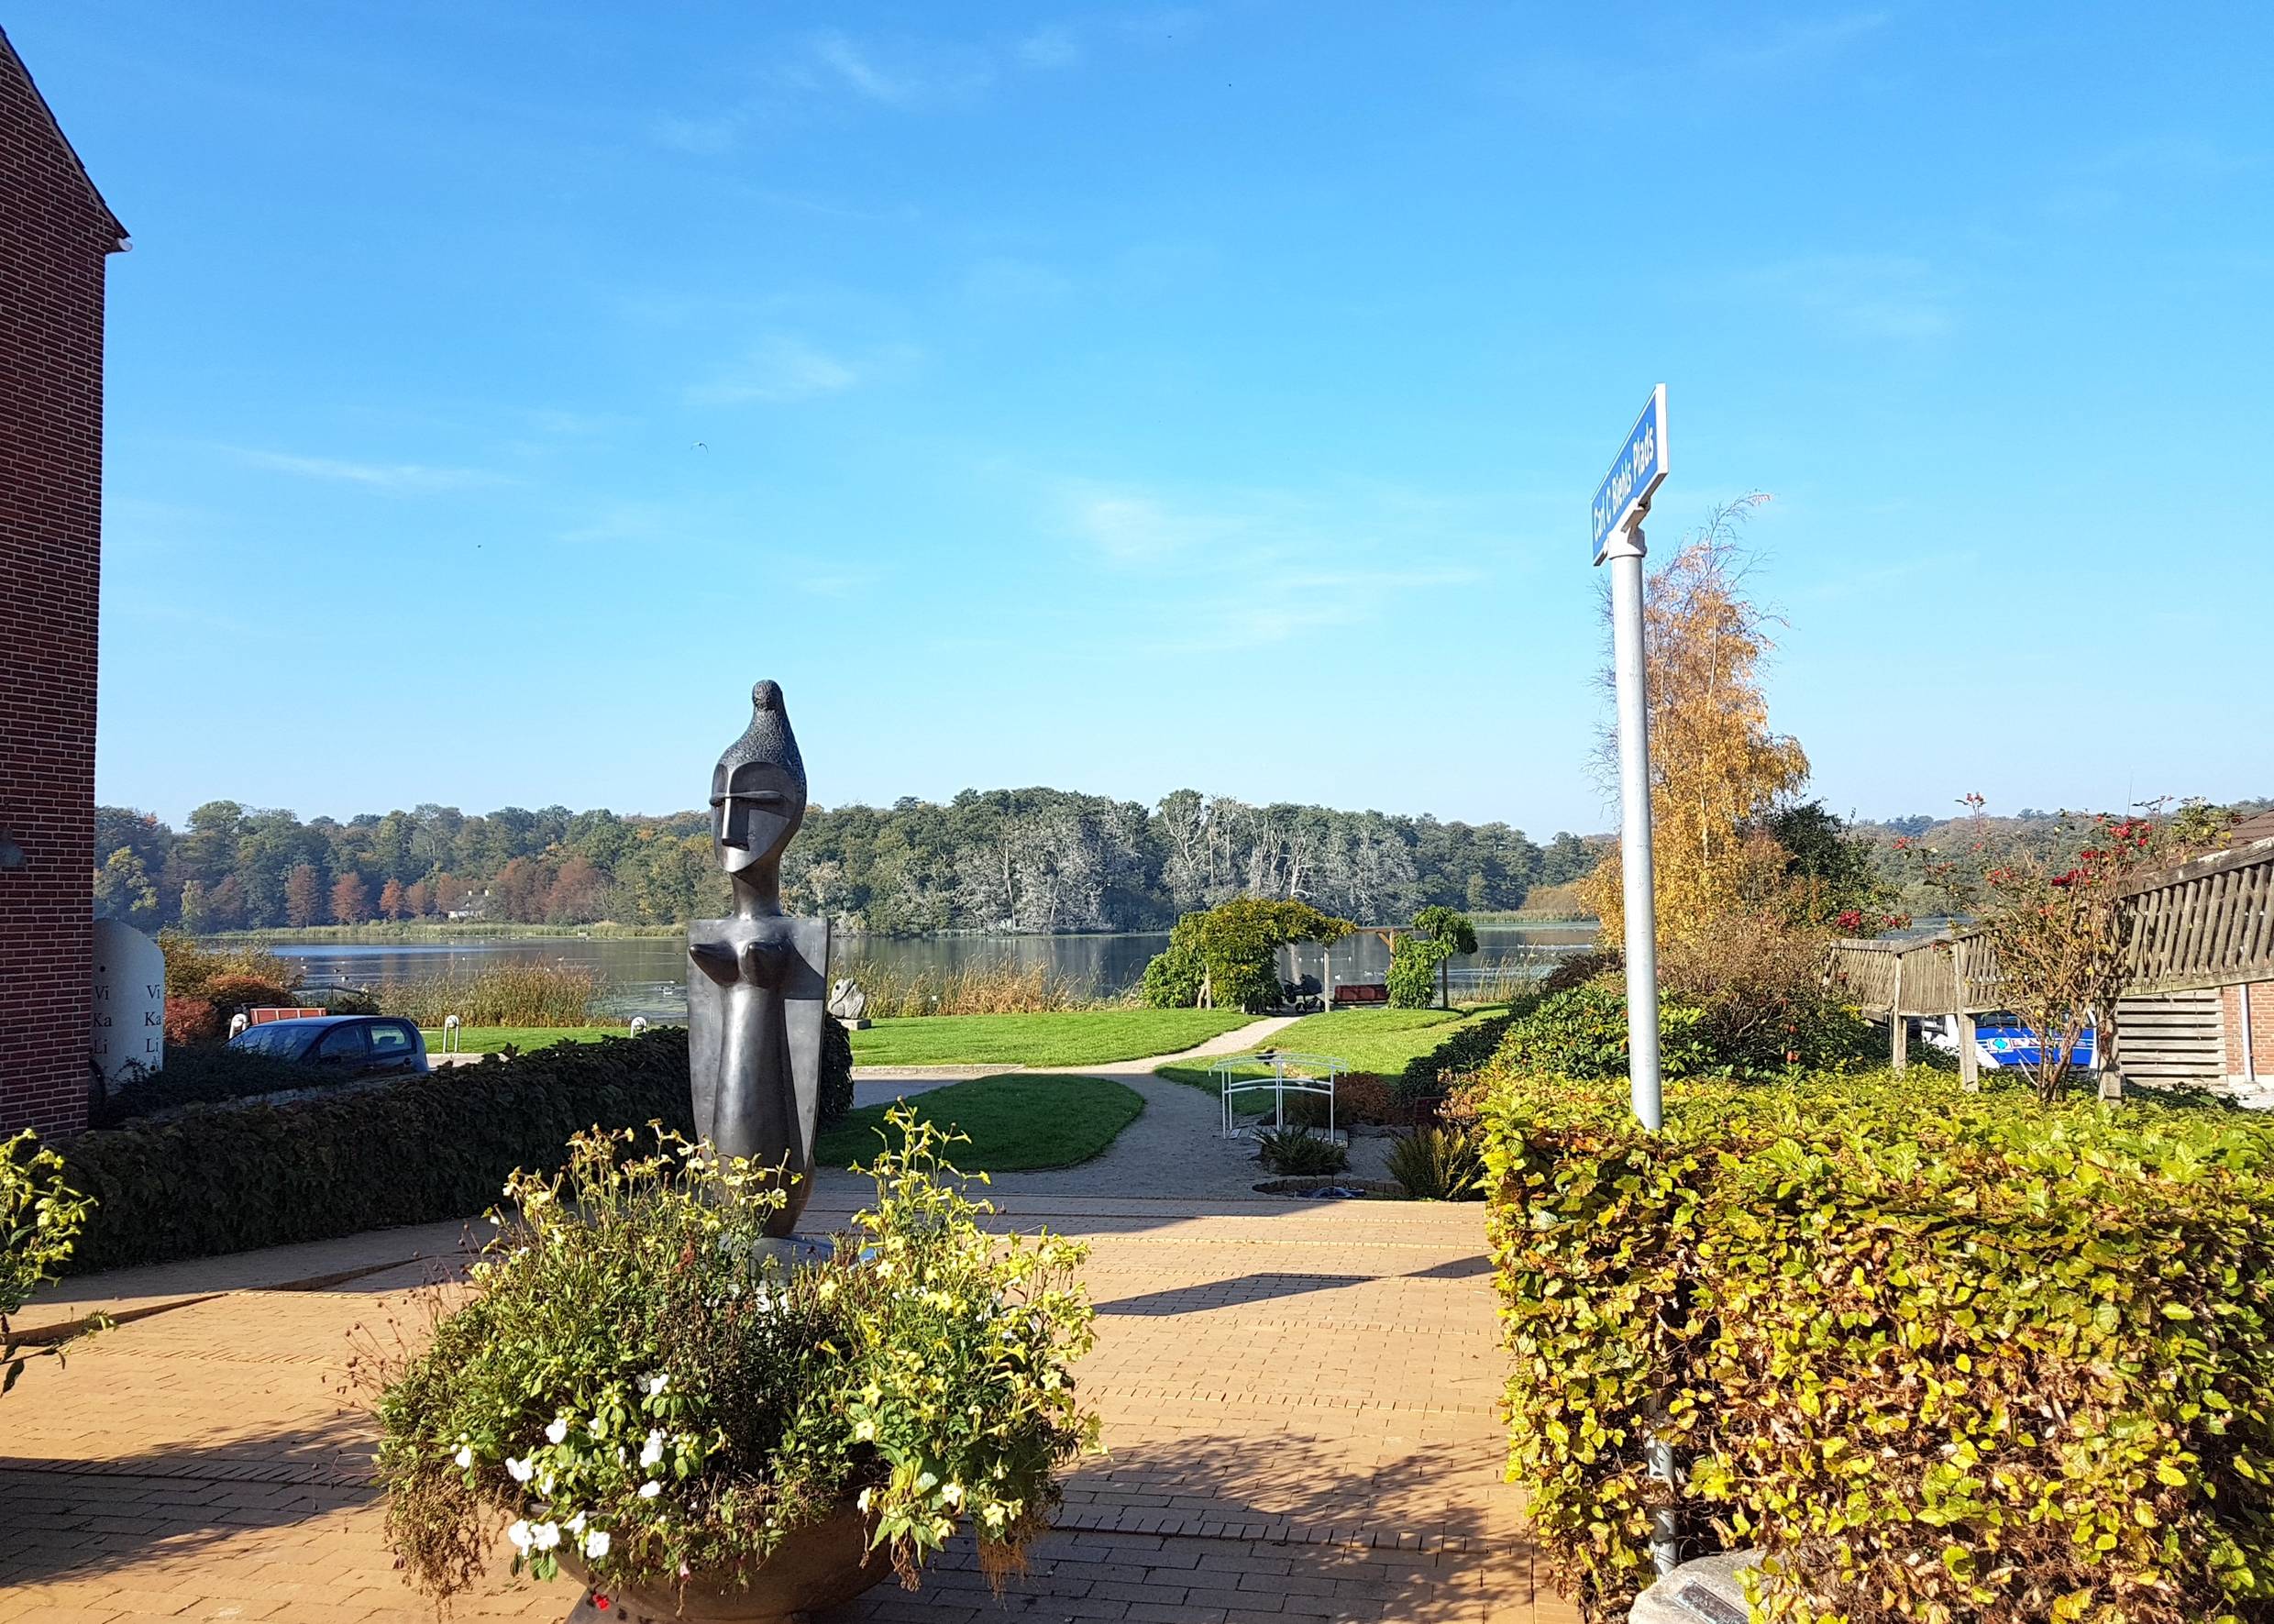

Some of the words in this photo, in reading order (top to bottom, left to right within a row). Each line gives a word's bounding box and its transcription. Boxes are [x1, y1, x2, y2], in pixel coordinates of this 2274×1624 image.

[1594, 495, 1606, 543] Carl
[1606, 485, 1612, 525] C
[1632, 421, 1654, 485] Plads
[94, 984, 110, 1000] Vi
[146, 983, 160, 1000] Vi
[93, 1011, 113, 1028] Ka
[144, 1011, 162, 1027] Ka
[94, 1038, 108, 1055] Li
[146, 1036, 160, 1054] Li
